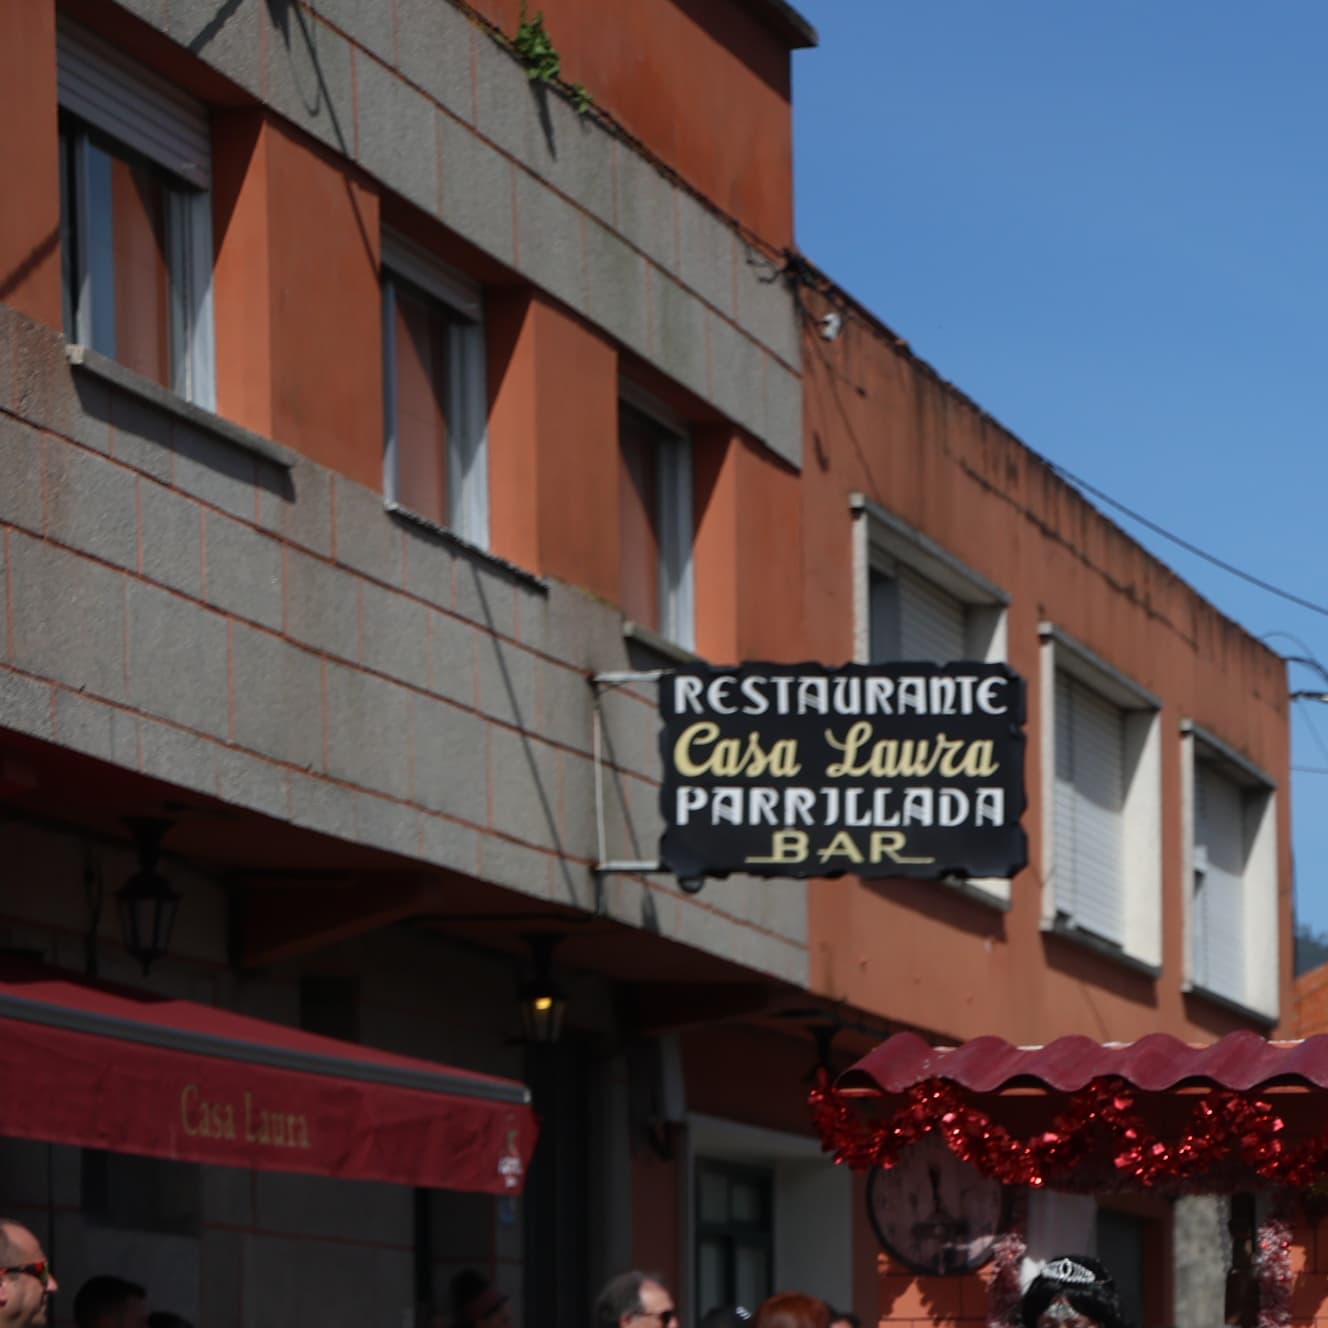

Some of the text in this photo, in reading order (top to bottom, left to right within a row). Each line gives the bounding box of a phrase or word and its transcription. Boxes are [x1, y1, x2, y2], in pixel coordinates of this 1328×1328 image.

[673, 676, 1008, 715] RESTAURANTE
[673, 721, 998, 778] Casa Laura
[676, 786, 1004, 827] PARRILLADA
[755, 831, 915, 864] BAR
[181, 1084, 236, 1139] Casa
